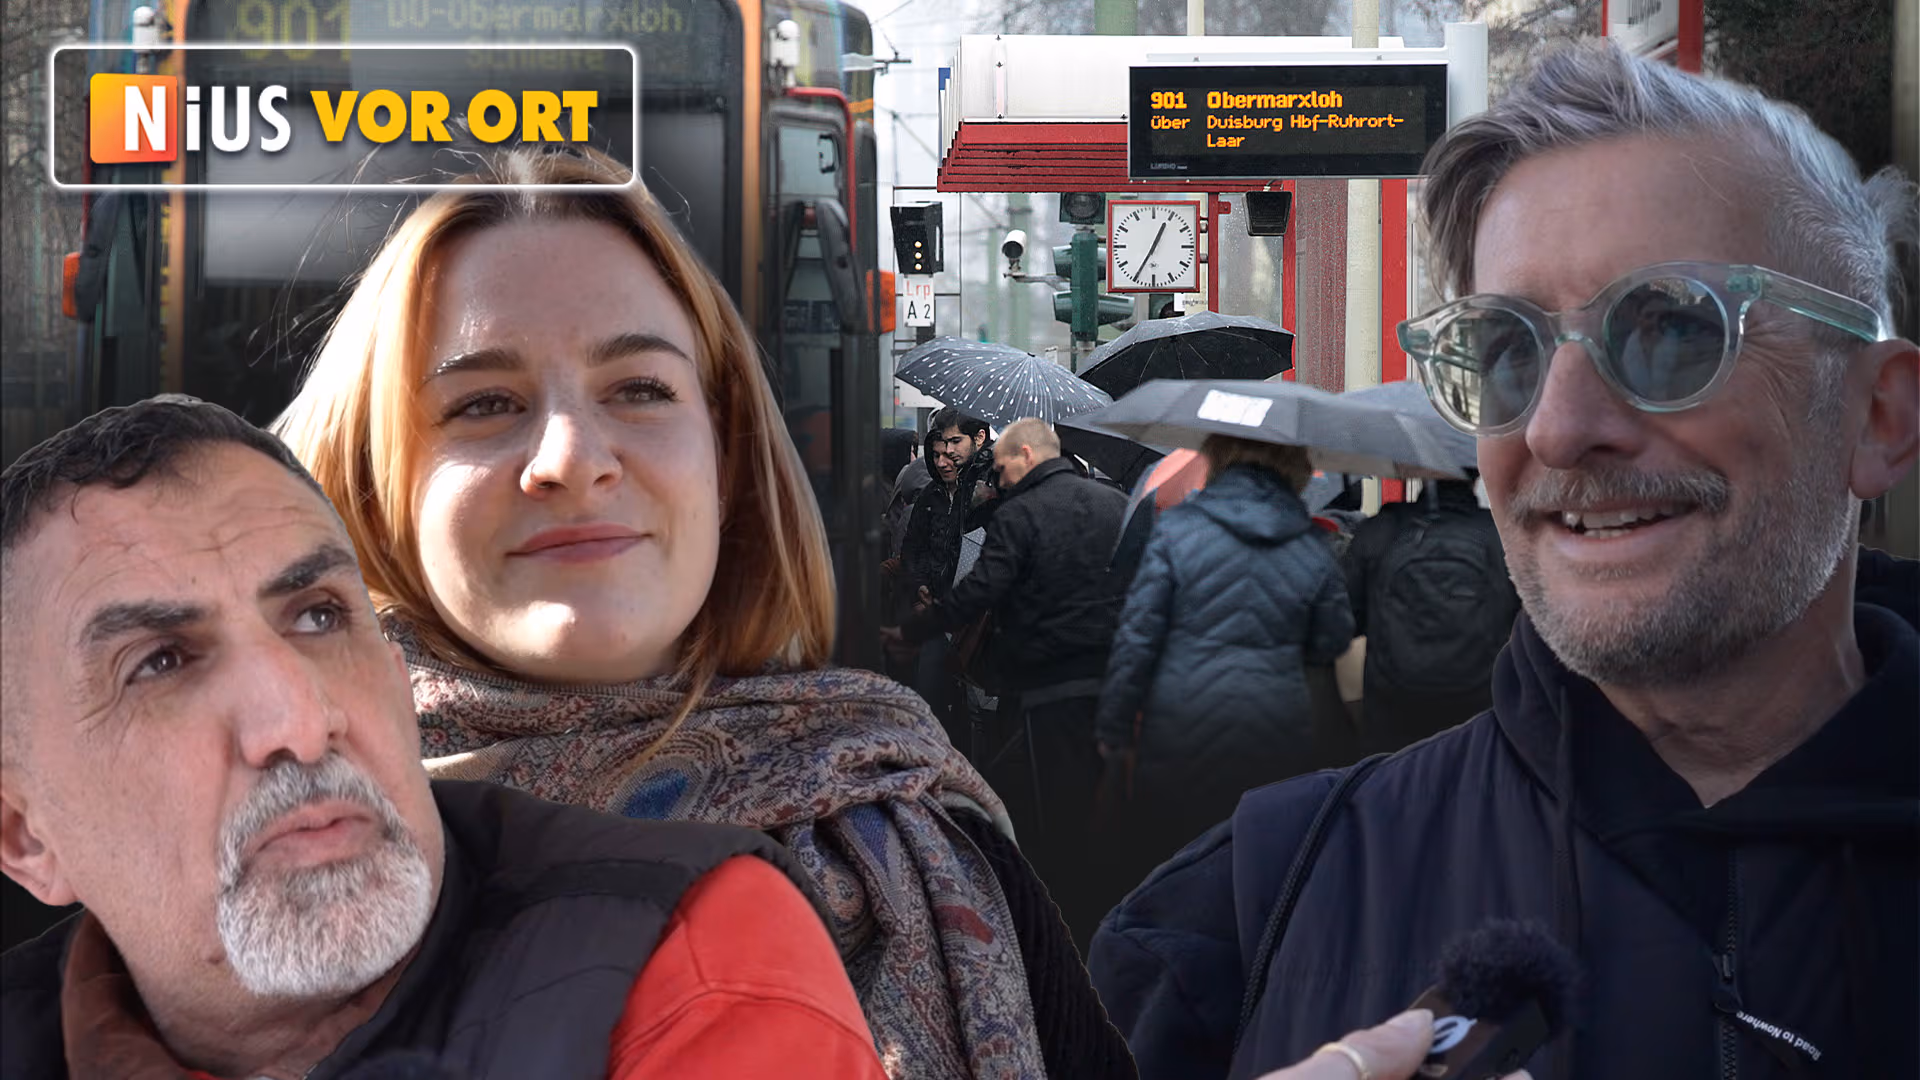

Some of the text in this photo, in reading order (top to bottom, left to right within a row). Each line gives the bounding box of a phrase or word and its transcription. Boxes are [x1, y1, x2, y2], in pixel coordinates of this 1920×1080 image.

[1150, 90, 1343, 109] 901 Obermarxloh
[1150, 114, 1404, 132] über Duisburg Hbf-Ruhrort-
[1206, 133, 1245, 148] Laar
[906, 280, 931, 300] Lrp
[907, 300, 931, 319] A 2
[1736, 1010, 1821, 1061] Road to Nowhere
